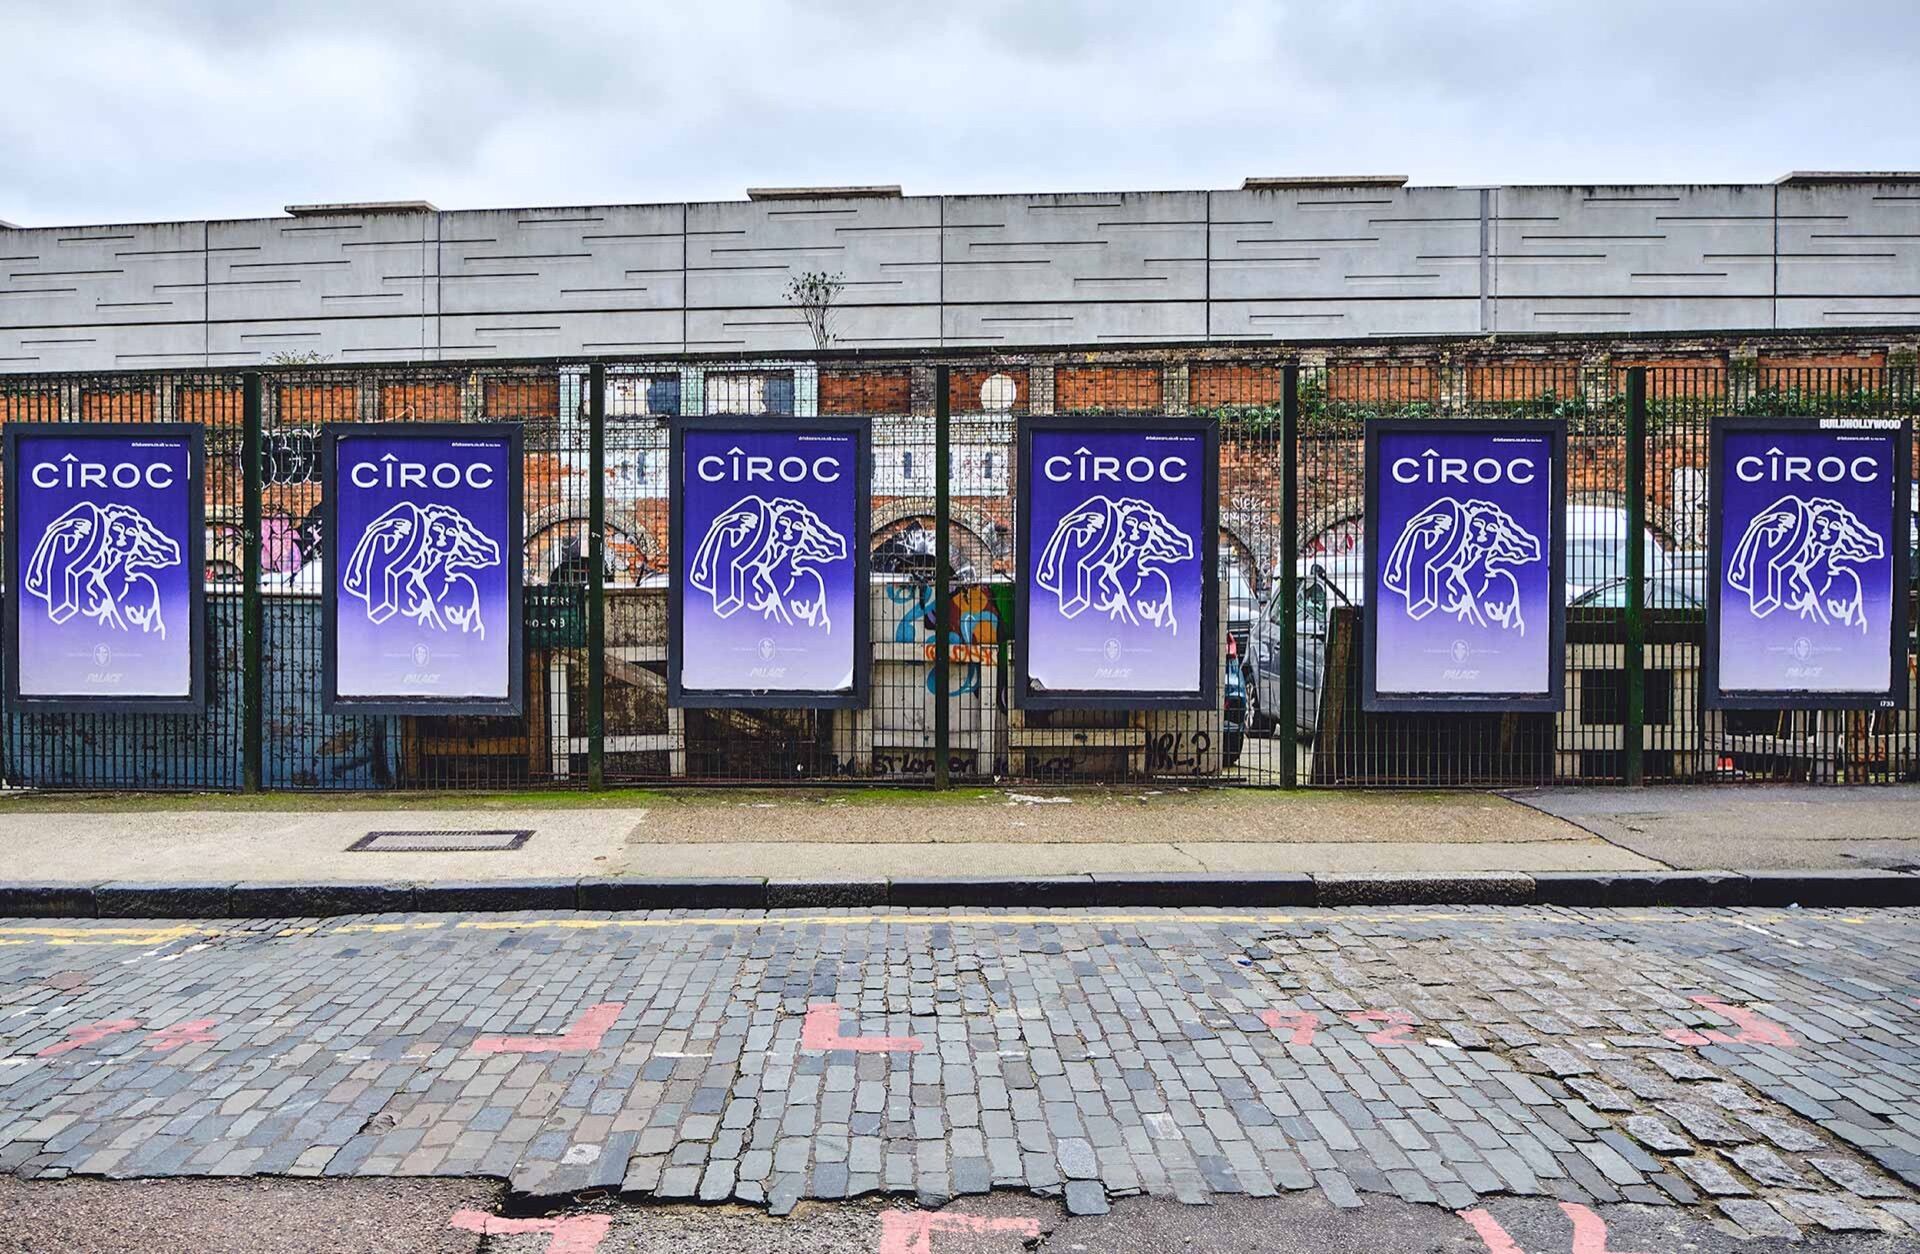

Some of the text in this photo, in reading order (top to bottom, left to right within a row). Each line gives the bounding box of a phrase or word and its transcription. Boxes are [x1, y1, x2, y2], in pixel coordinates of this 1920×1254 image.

[31, 452, 173, 489] CÎROC
[351, 452, 493, 489] CÎROC
[697, 446, 840, 483] CÎROC
[1044, 446, 1187, 483] CÎROC
[1392, 448, 1535, 484] CÎROC
[1736, 446, 1878, 483] CÎROC
